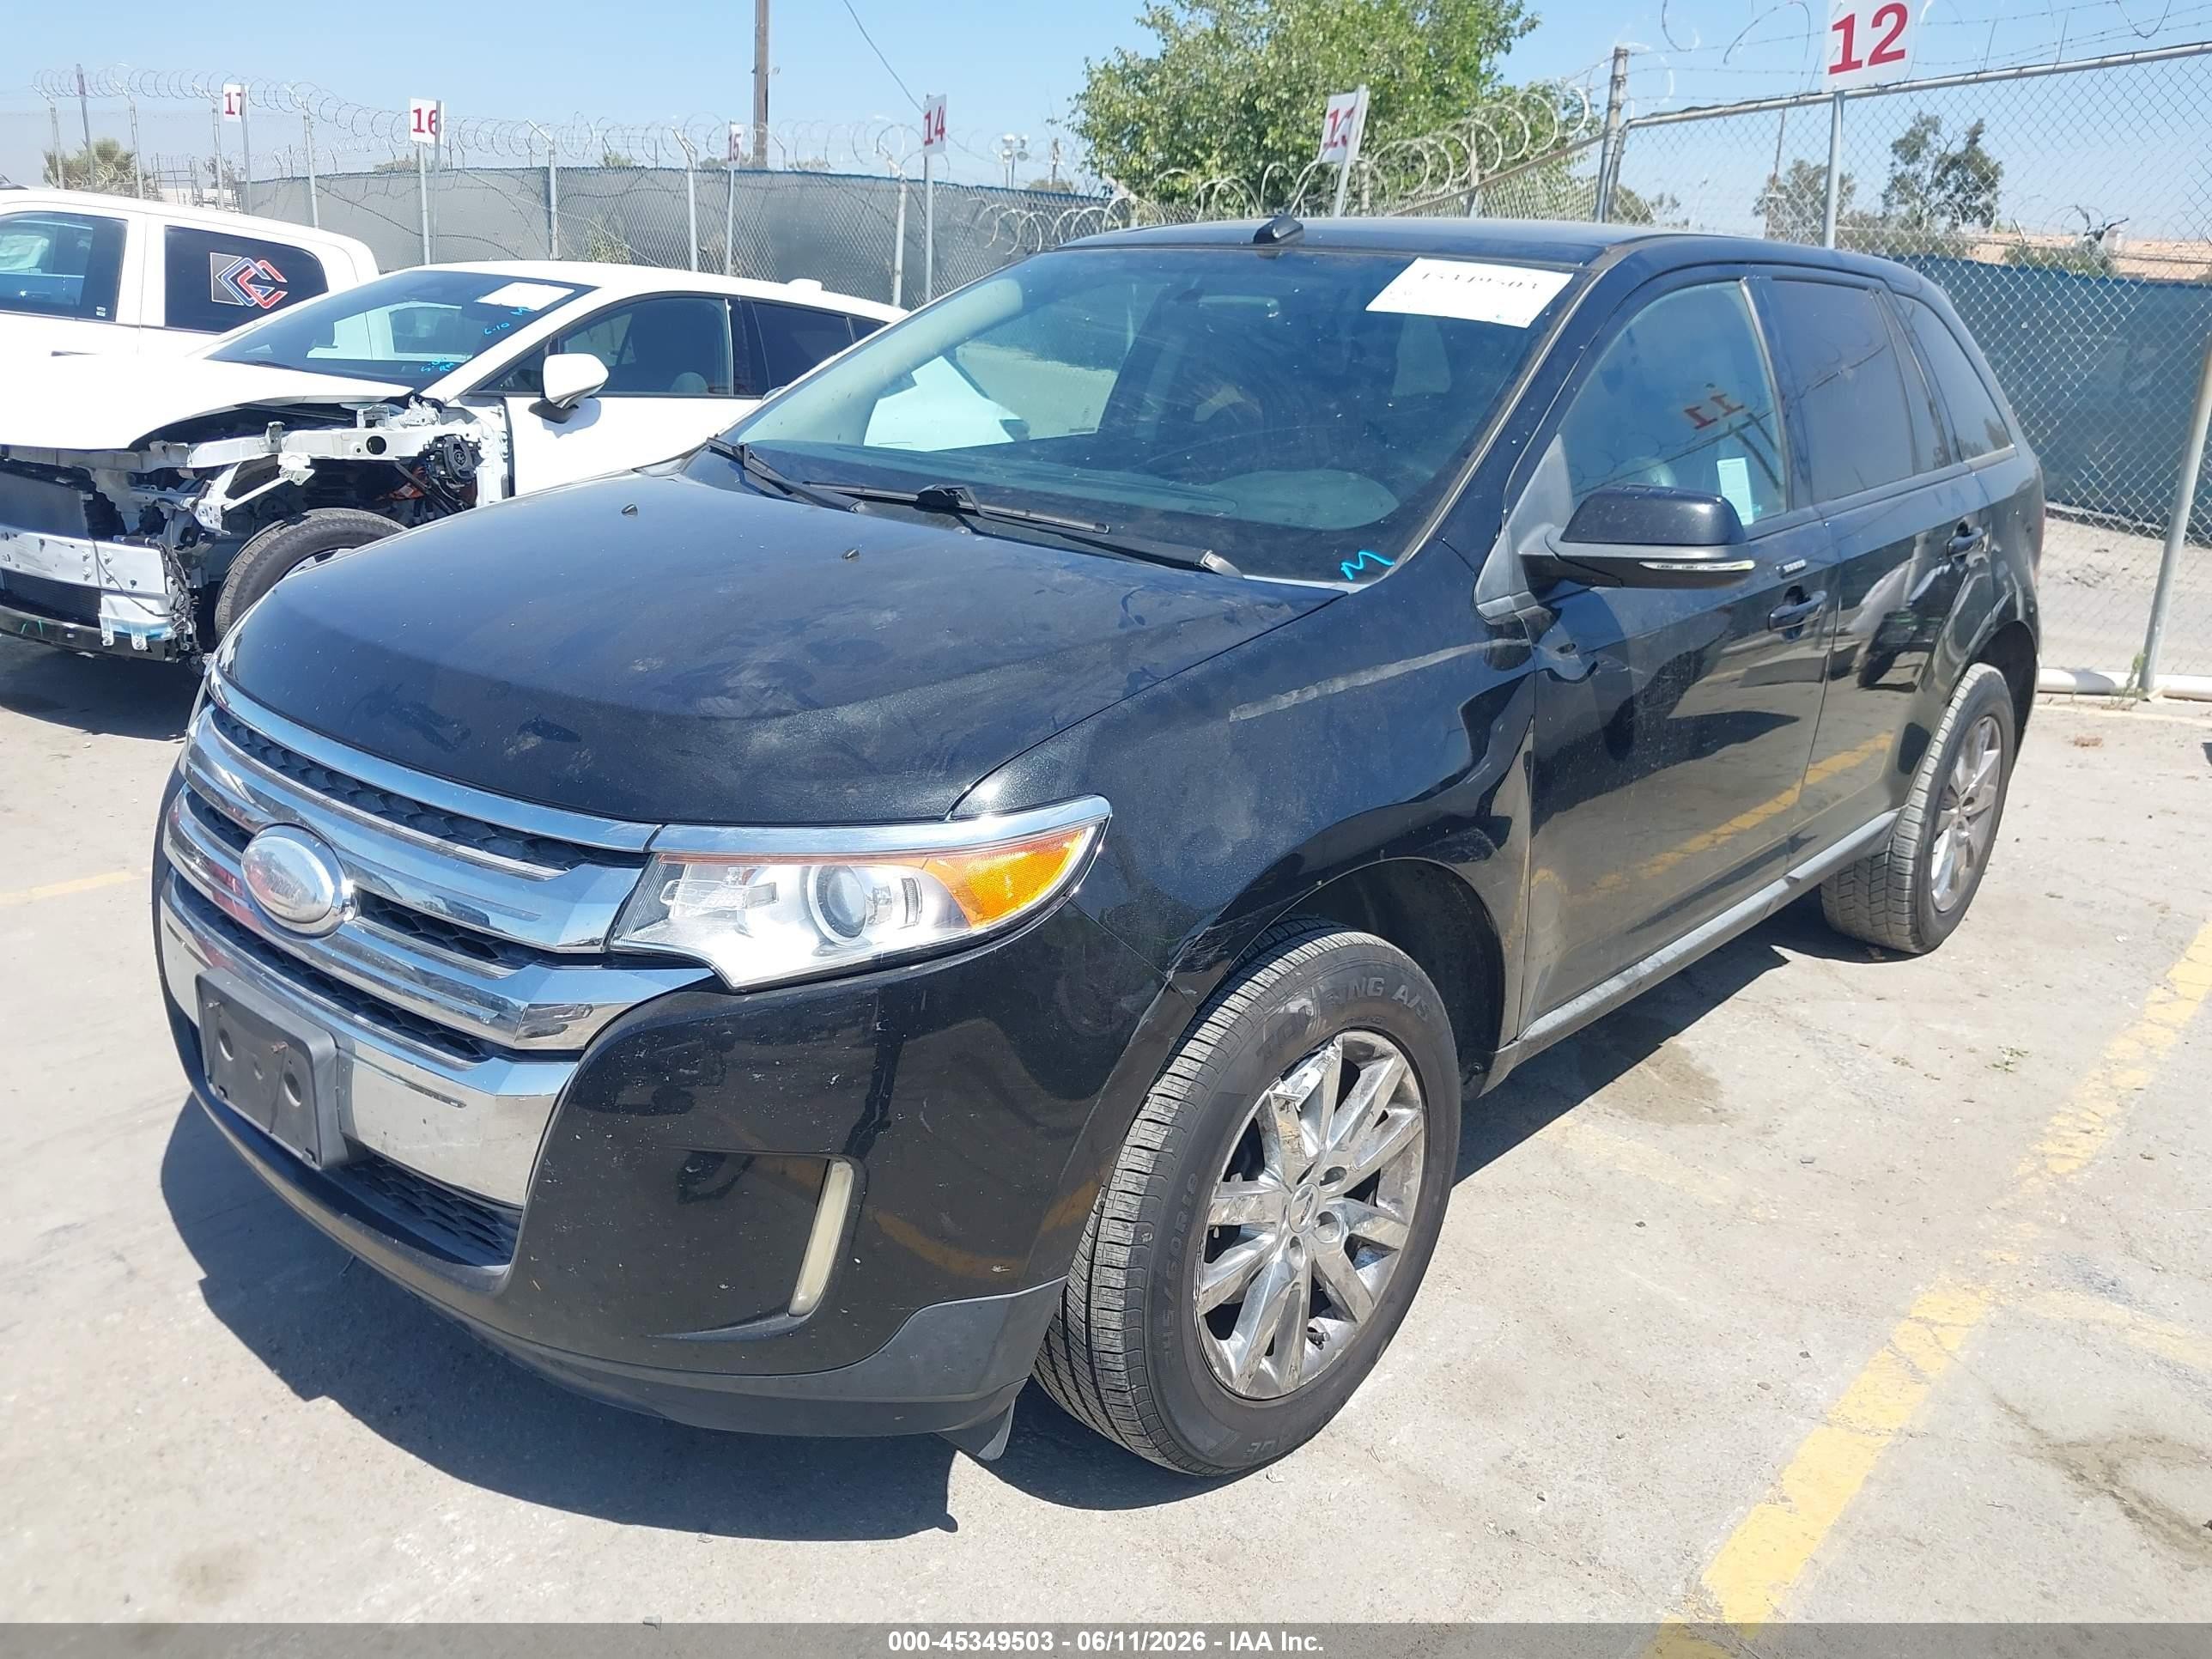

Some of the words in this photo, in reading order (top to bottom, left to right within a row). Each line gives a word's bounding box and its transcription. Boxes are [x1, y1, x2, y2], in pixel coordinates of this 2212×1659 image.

[1828, 3, 1908, 75] 12
[412, 107, 441, 136] 16
[924, 106, 945, 146] 14
[728, 133, 741, 161] 15
